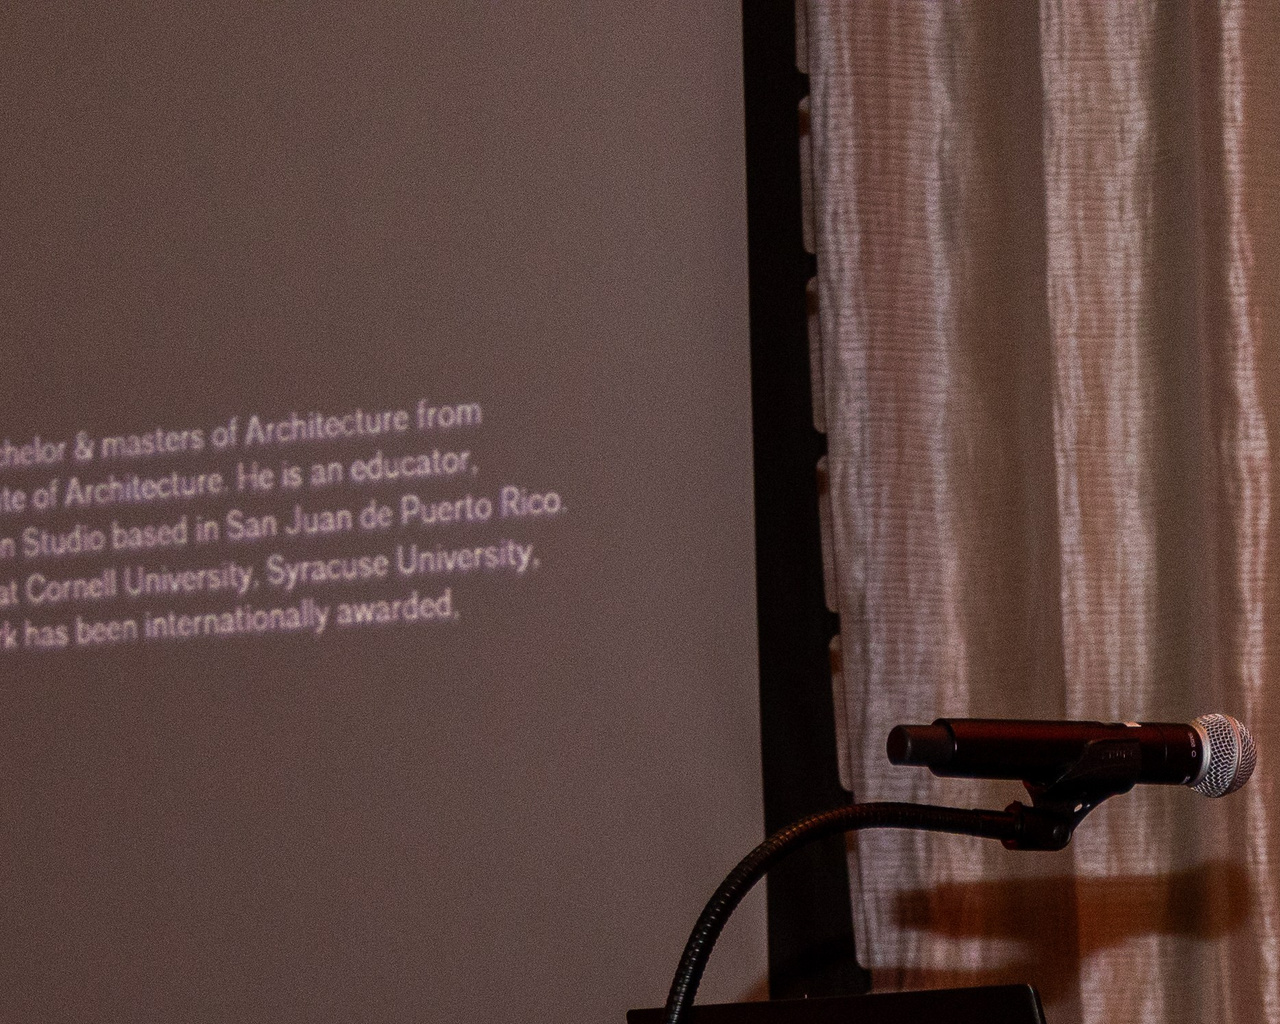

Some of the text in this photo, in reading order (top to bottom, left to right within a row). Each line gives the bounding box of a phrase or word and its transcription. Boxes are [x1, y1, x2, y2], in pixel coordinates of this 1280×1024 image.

[75, 430, 95, 461] &
[102, 428, 204, 458] masters
[211, 415, 238, 448] of
[245, 407, 409, 446] Architecture
[416, 400, 482, 430] from
[0, 486, 26, 513] te
[33, 478, 58, 509] of
[237, 462, 275, 491] He
[281, 461, 303, 488] is
[311, 461, 344, 486] an
[22, 524, 106, 557] Studio
[111, 515, 188, 550] based
[195, 516, 220, 542] in
[226, 508, 278, 540] San
[285, 504, 352, 535] Juan
[359, 500, 394, 530] de
[400, 494, 493, 525] Puerto
[25, 567, 117, 604] Cornell
[266, 553, 389, 593] Syracuse
[24, 619, 69, 648] has
[75, 615, 138, 645] been
[144, 597, 330, 638] internationally
